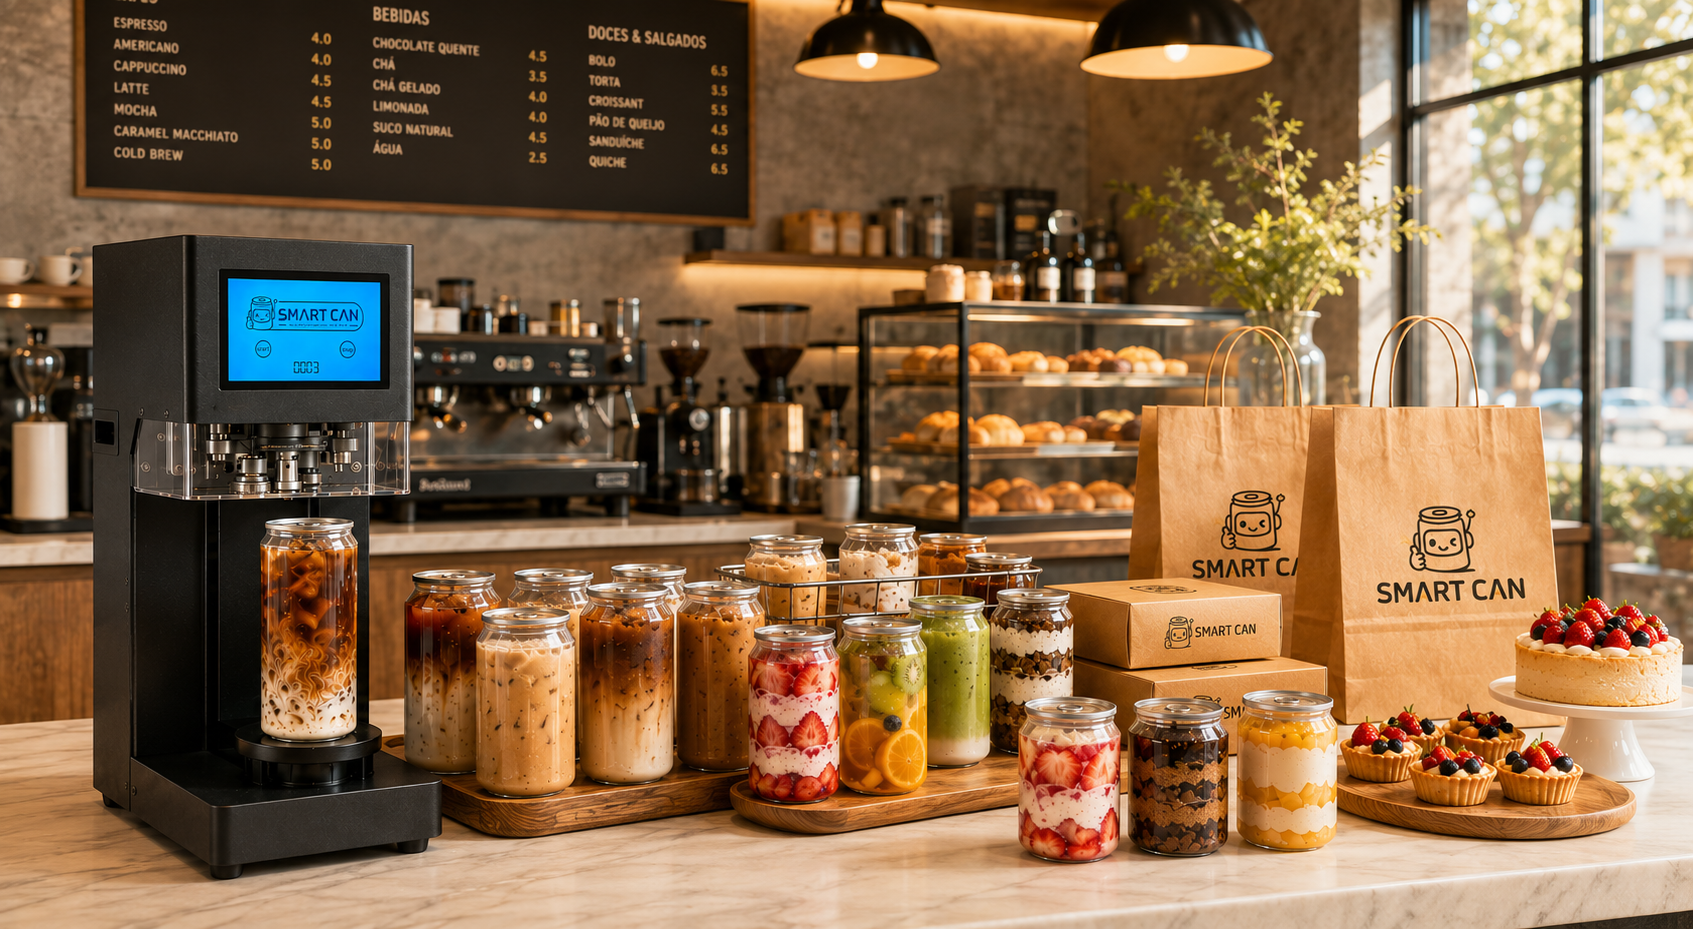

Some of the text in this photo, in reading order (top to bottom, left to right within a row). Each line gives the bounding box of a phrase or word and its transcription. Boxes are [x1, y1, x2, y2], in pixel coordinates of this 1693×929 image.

[373, 6, 429, 26] BEBIDAS
[114, 17, 332, 45] ESPRESSO 4.0
[588, 25, 707, 49] DOCES & SALGADOS
[114, 39, 332, 66] AMERICANO 4.0
[373, 37, 547, 62] CHOCOLATE QUENTE 4.5
[114, 60, 332, 87] CAPPUCCINO 4.5
[373, 56, 547, 82] CHÁ 3.5
[588, 54, 728, 77] BOLO 6.5
[373, 77, 547, 103] CHÁ GELADO 4.0
[588, 75, 621, 87] TORTA
[114, 82, 332, 108] LATTE 4.5
[588, 95, 728, 116] CROISSANT 5.5
[114, 104, 332, 129] MOCHA 5.0
[373, 100, 547, 123] LIMONADA 4.0
[373, 121, 547, 143] SUCO NATURAL 4.5
[589, 113, 728, 136] PÃO DE QUEIJO 4.5
[114, 125, 332, 150] CARAMEL MACCHIATO 5.0
[588, 135, 728, 155] SANDUÍCHE 6.5
[114, 147, 332, 171] COLD BREW 5.0
[373, 140, 547, 163] ÁGUA 2.5
[588, 155, 728, 175] QUICHE 6.5
[278, 308, 359, 322] SMART CAN
[293, 361, 319, 374] 0003
[1192, 558, 1270, 579] SMART
[1377, 577, 1526, 604] SMART CAN
[1195, 623, 1256, 638] SMART CAN
